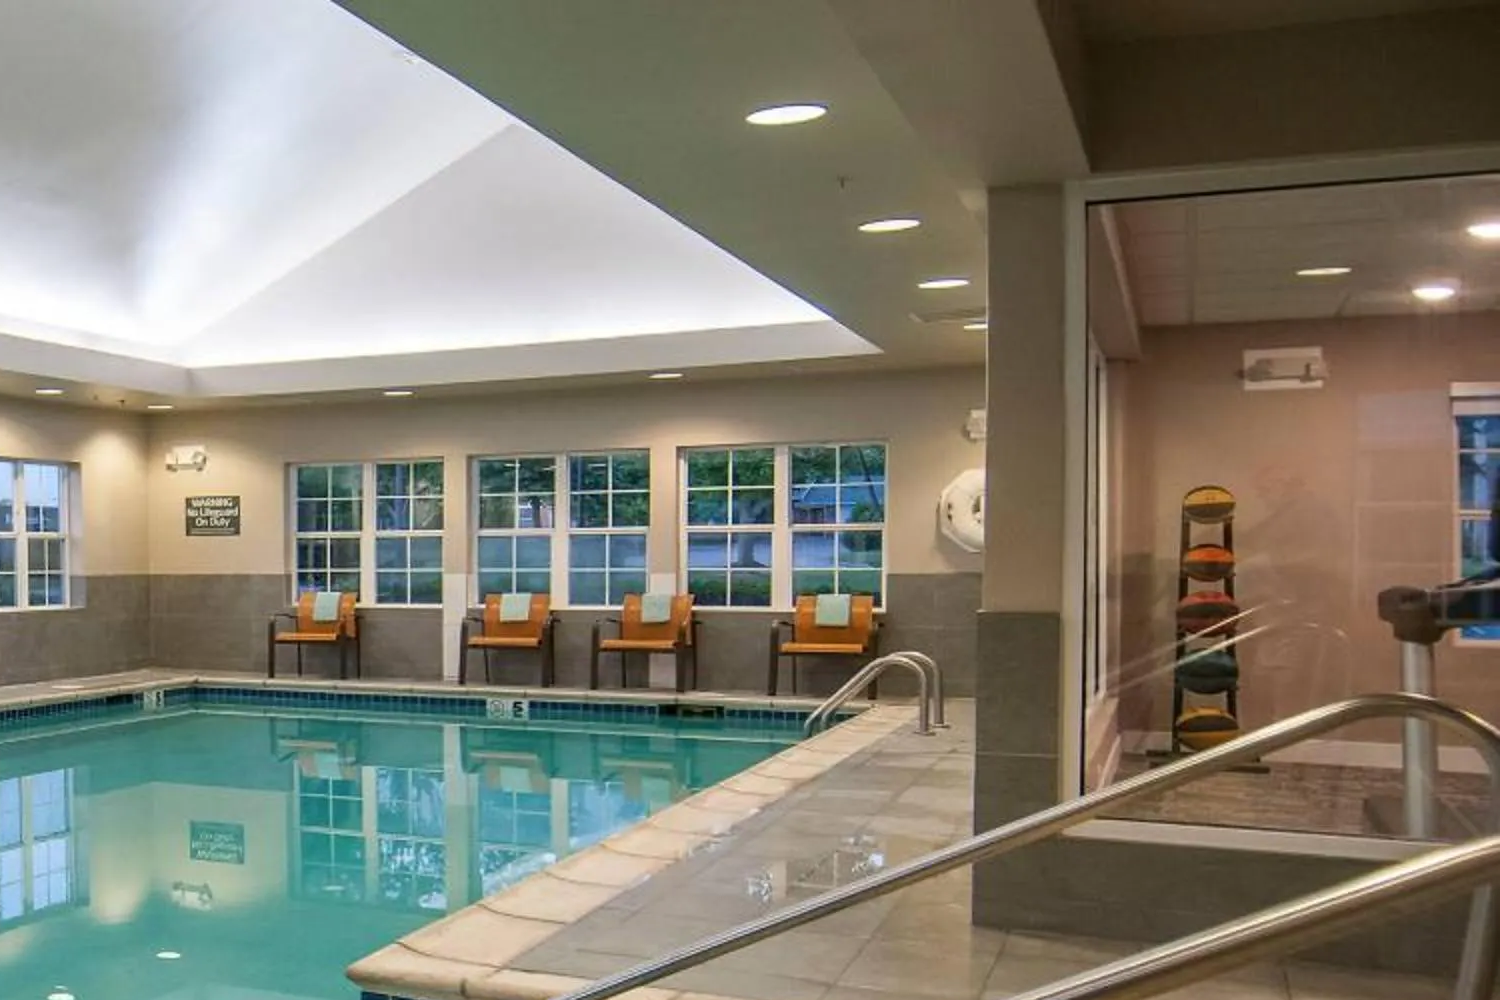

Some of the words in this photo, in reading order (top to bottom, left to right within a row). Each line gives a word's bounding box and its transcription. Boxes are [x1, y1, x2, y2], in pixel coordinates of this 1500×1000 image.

[191, 497, 233, 507] WARNING
[195, 517, 209, 527] On
[210, 517, 231, 528] Duty
[512, 701, 524, 718] 5
